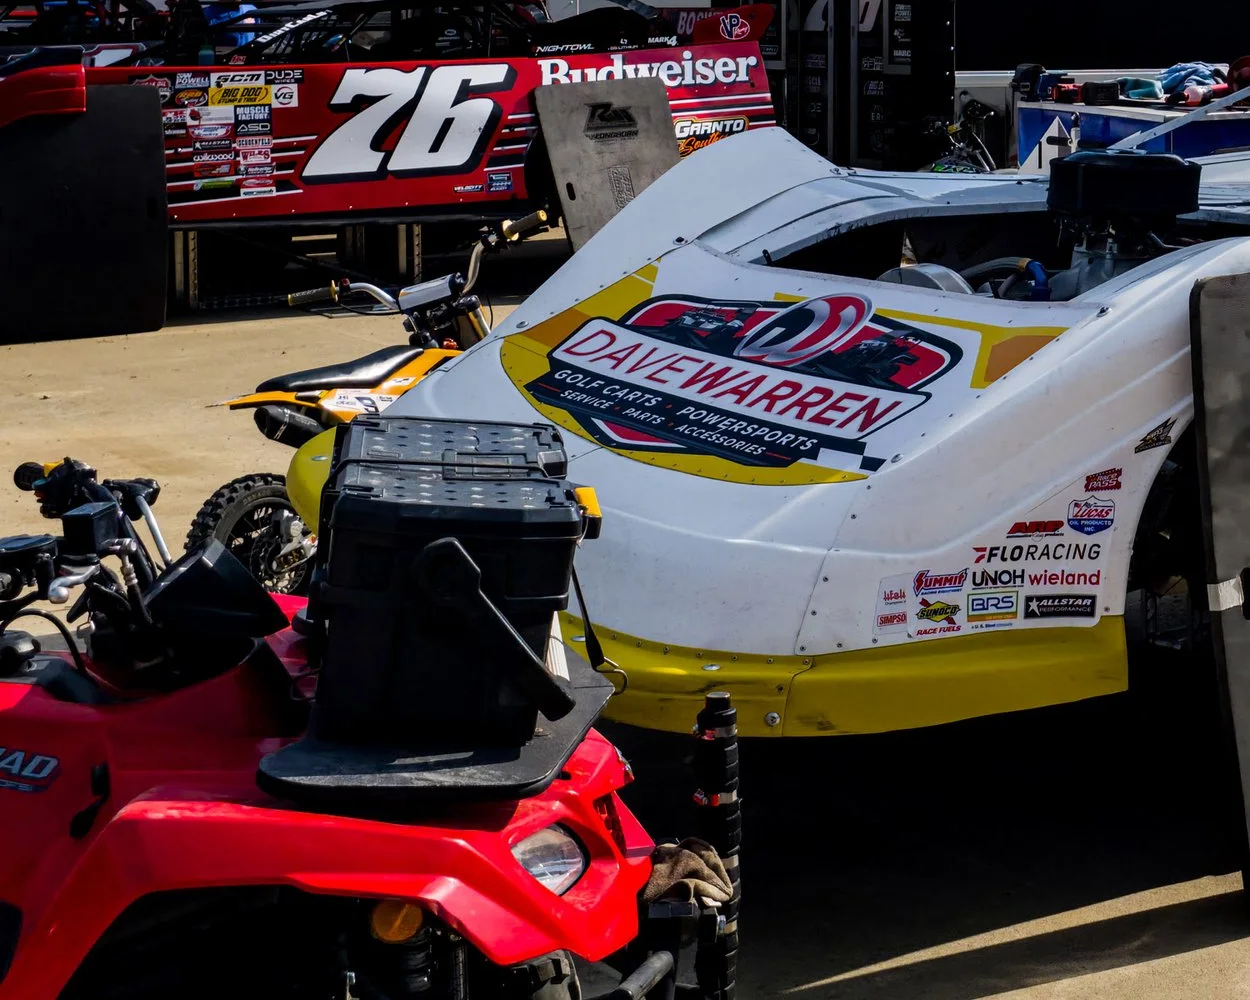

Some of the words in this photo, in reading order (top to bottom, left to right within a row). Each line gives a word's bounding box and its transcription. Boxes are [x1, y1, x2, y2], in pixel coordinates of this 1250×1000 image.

[536, 43, 595, 53] NIGHTOWL
[266, 70, 303, 80] DUDE
[538, 51, 757, 87] Budweiser
[237, 106, 269, 114] MUSCLE
[303, 65, 509, 179] 76
[193, 151, 234, 161] wilwood
[554, 369, 605, 390] GOLF
[602, 385, 662, 407] CARTS
[676, 406, 818, 451] POWERSPORTS
[560, 390, 614, 411] SERVICE
[622, 408, 665, 425] PARTS
[674, 424, 767, 455] ACCESSORIES
[1073, 508, 1113, 518] LUCAS
[972, 568, 1025, 587] UNOH
[1028, 569, 1101, 586] wieland
[972, 596, 1014, 611] BRS
[1040, 598, 1092, 606] ALLSTAR
[920, 606, 957, 618] SUNOCO
[879, 613, 907, 625] SIMPSO
[917, 627, 938, 636] RACE
[939, 625, 961, 634] FUELS
[0, 748, 58, 778] AD
